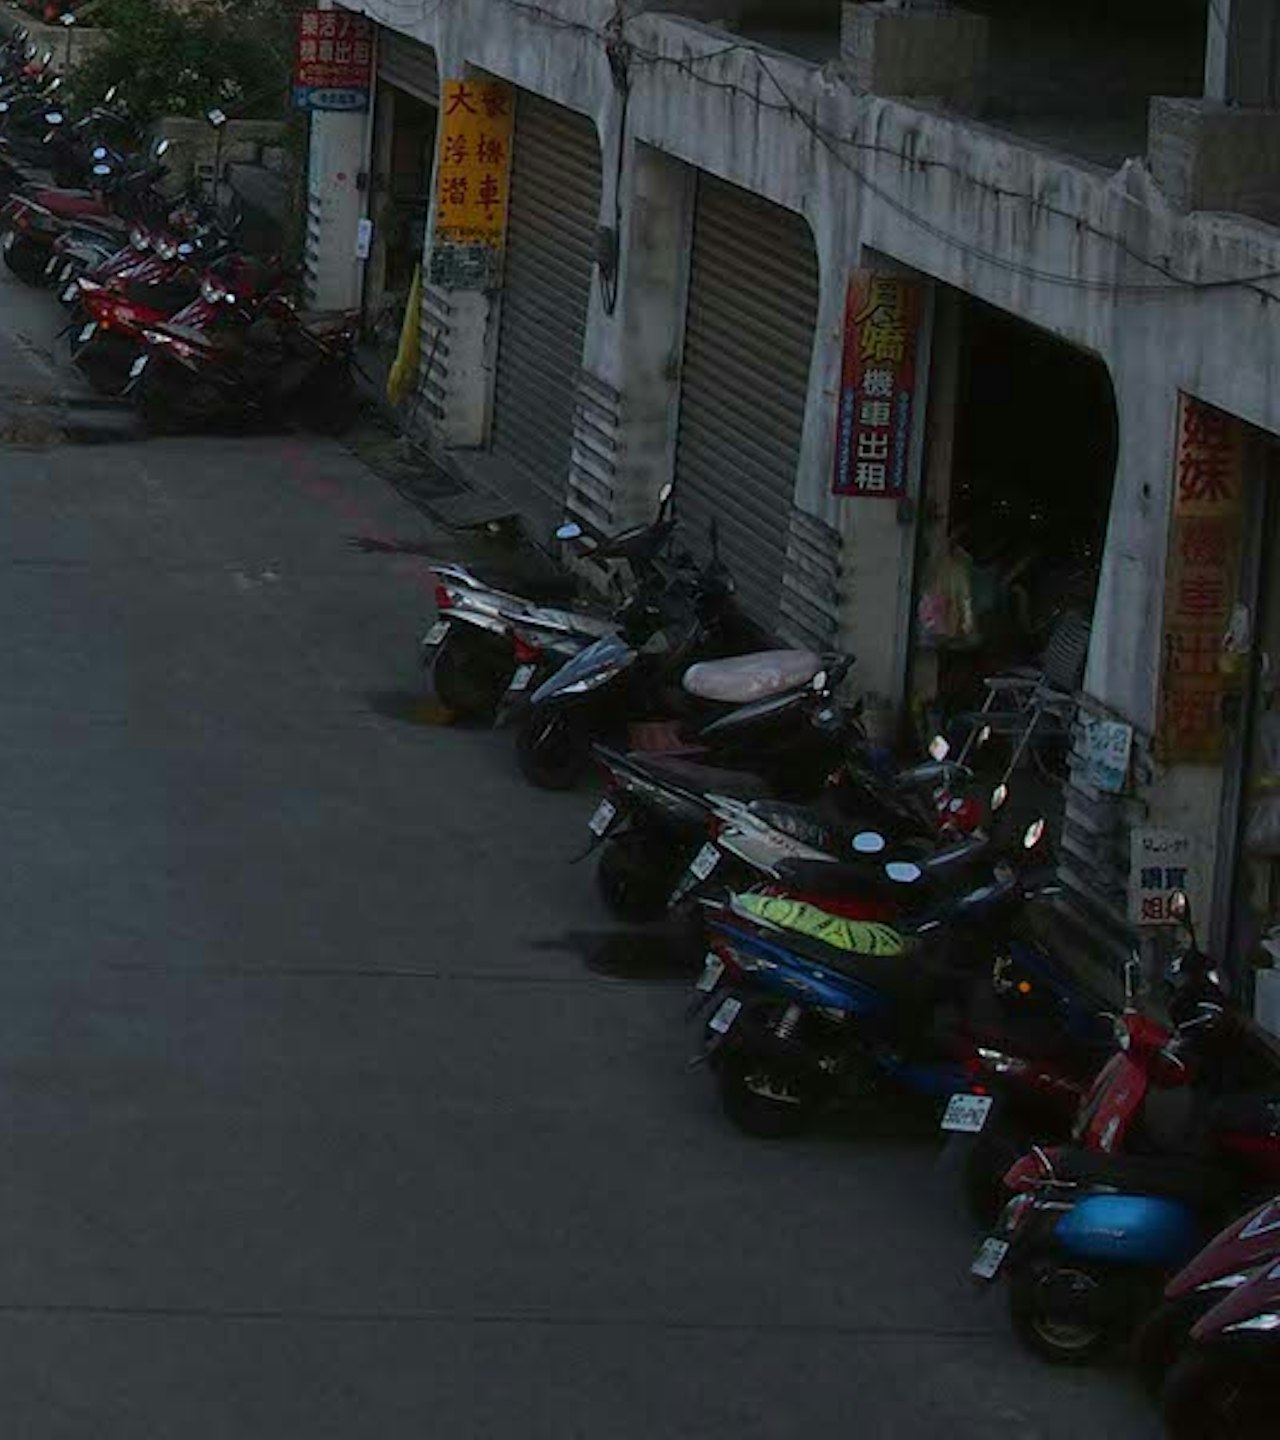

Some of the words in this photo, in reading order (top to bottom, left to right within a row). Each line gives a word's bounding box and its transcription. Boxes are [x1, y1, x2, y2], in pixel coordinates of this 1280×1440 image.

[441, 135, 470, 205] 浮潛
[475, 133, 506, 210] 機車
[854, 368, 895, 492] 機車出租
